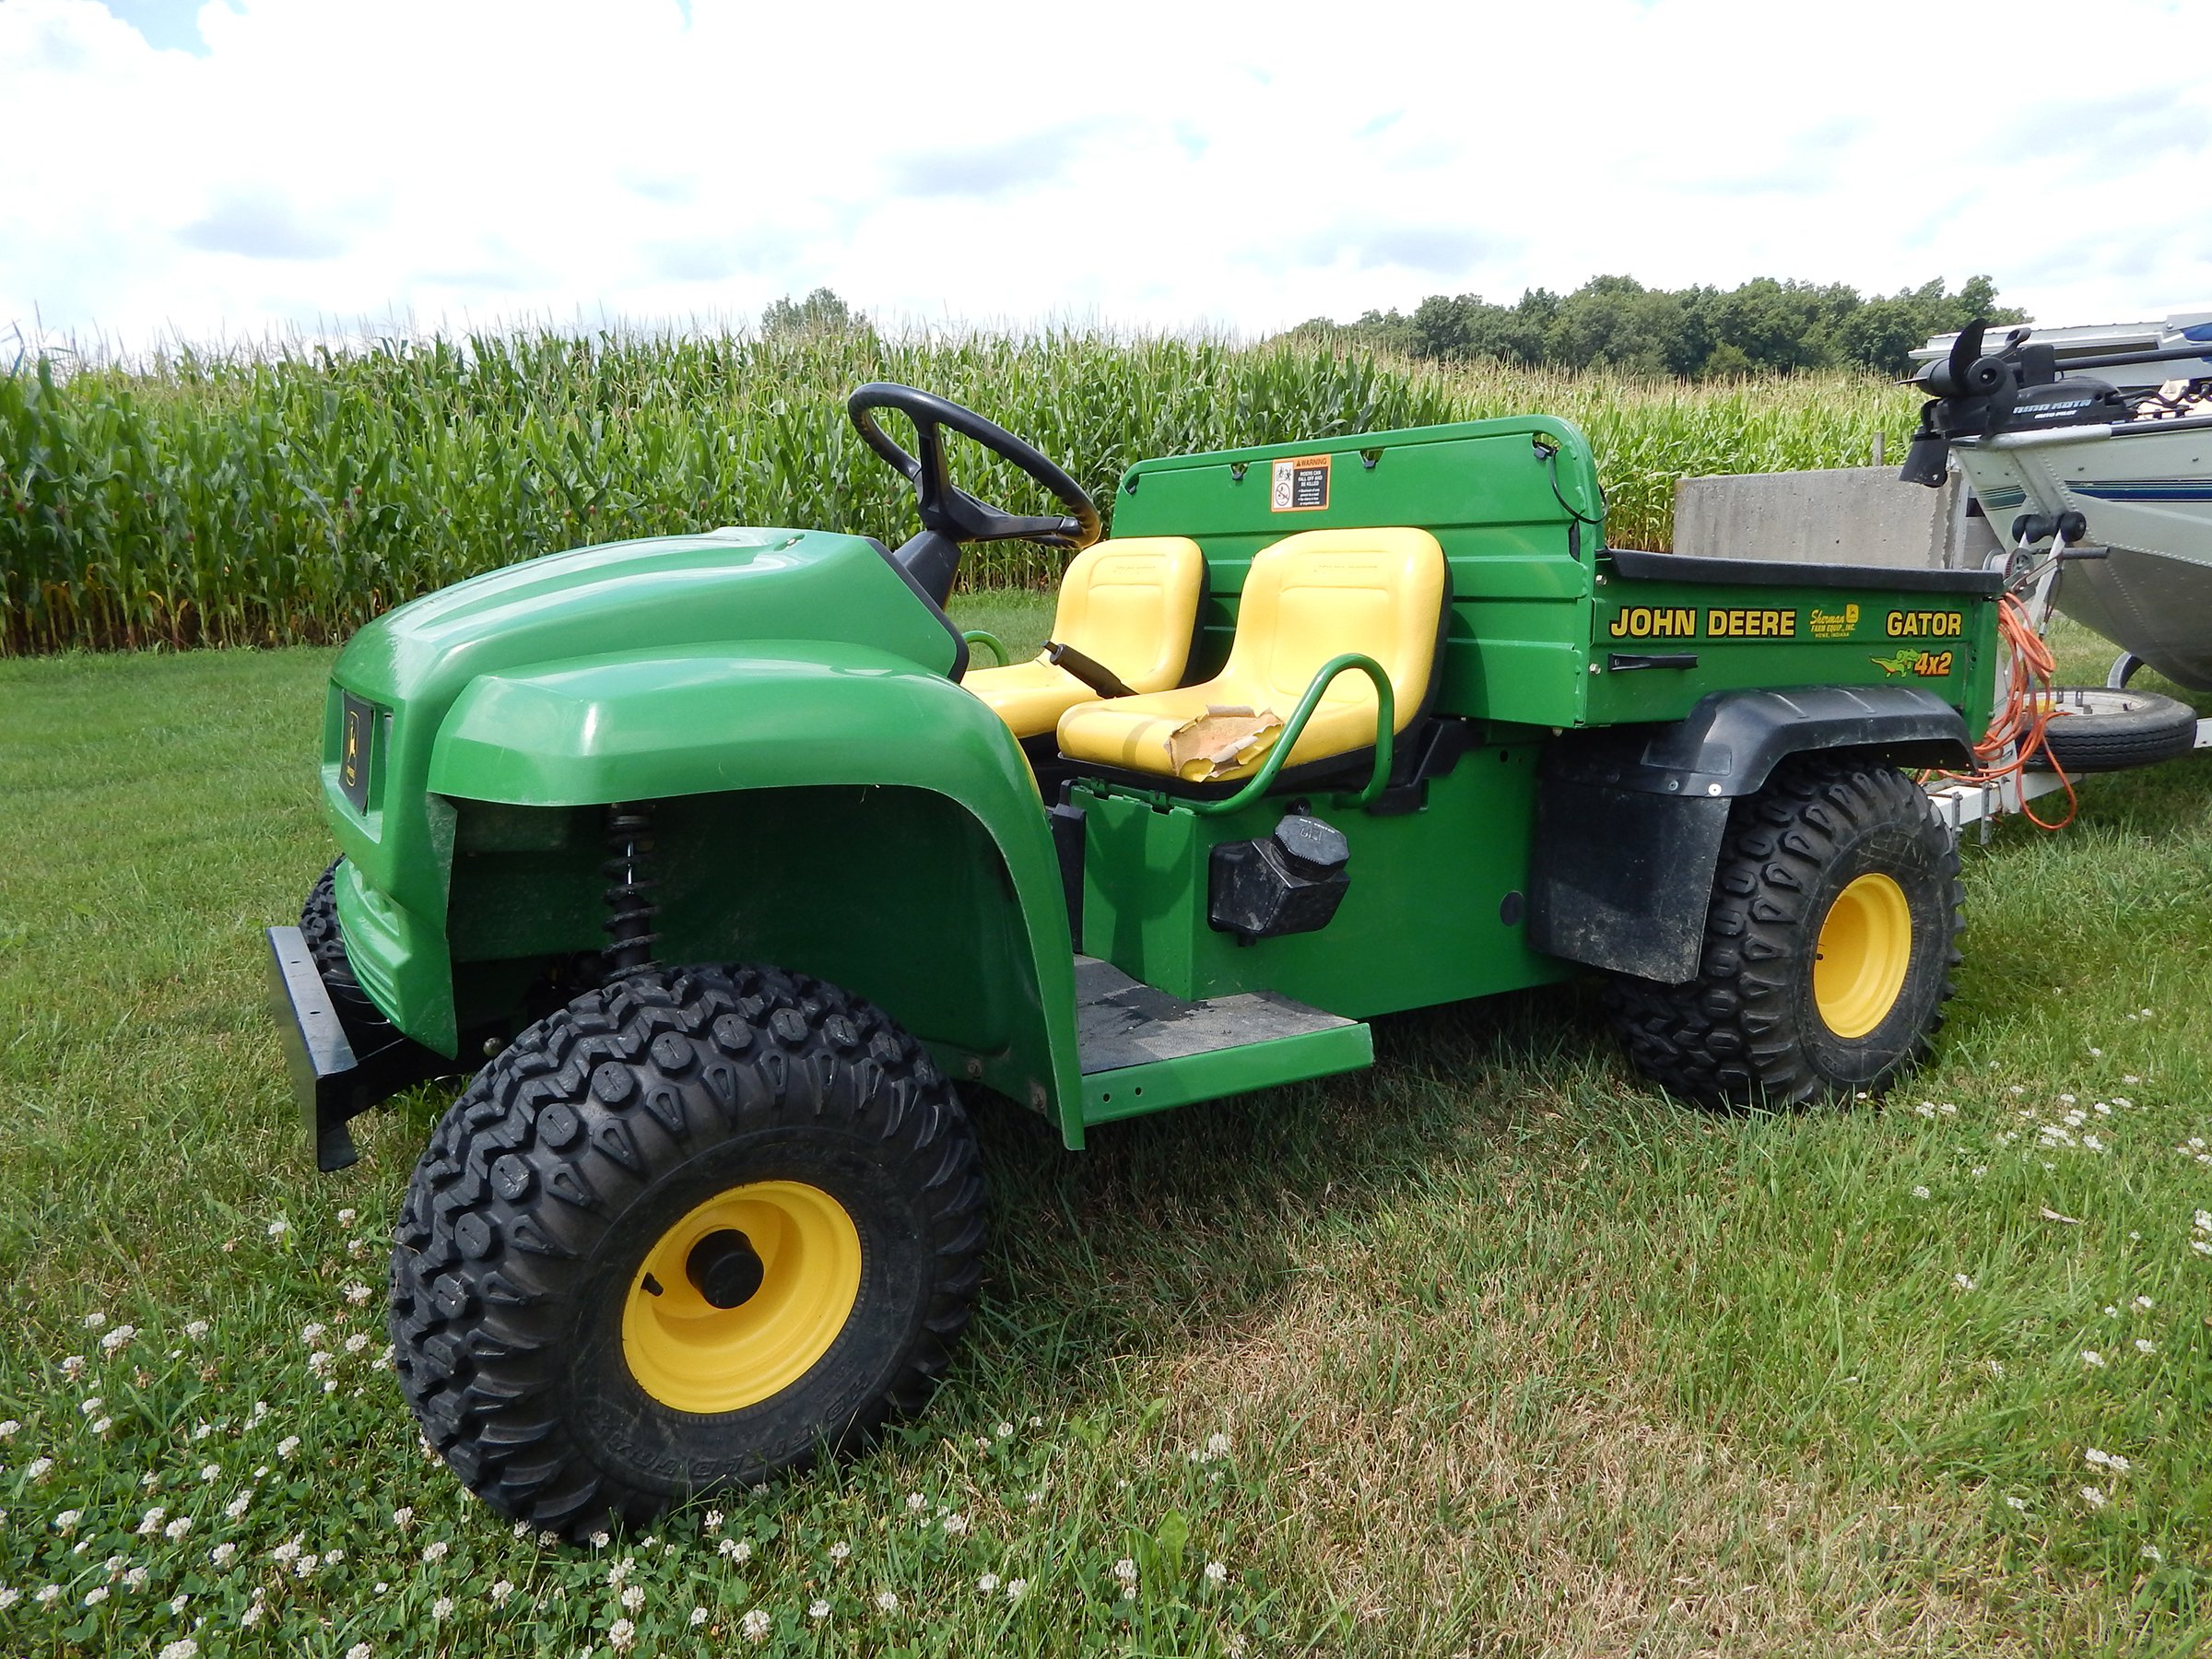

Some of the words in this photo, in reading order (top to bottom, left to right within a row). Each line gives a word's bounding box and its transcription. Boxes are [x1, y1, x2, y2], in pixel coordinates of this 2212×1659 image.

[1301, 457, 1326, 466] WARNING
[1610, 607, 1697, 637] JOHN
[1707, 609, 1796, 637] DEERE
[1810, 609, 1844, 624] Sherman
[1886, 610, 1962, 637] GATOR
